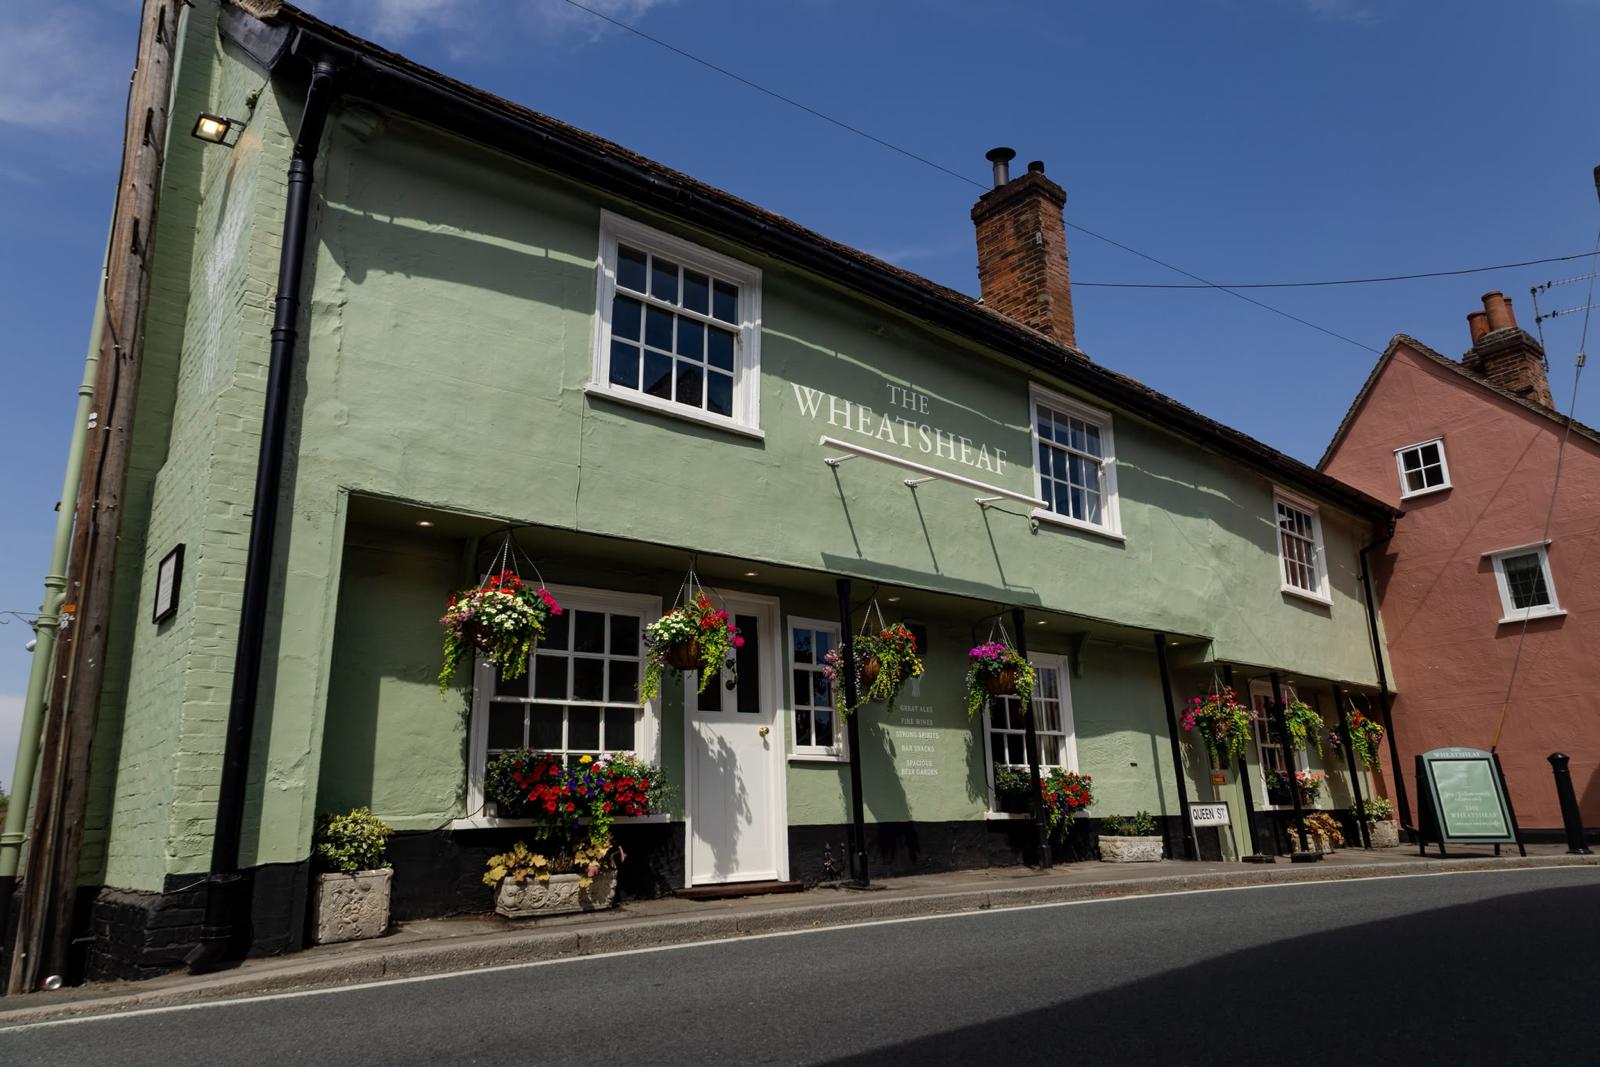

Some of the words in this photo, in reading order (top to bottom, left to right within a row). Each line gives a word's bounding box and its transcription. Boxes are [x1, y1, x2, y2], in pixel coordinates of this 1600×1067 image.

[886, 383, 930, 415] THE
[790, 382, 1008, 476] WHEATSHEAF
[900, 704, 918, 712] GREAT
[895, 730, 917, 738] STRONG
[1193, 808, 1215, 820] QUEEN
[1216, 807, 1226, 820] ST
